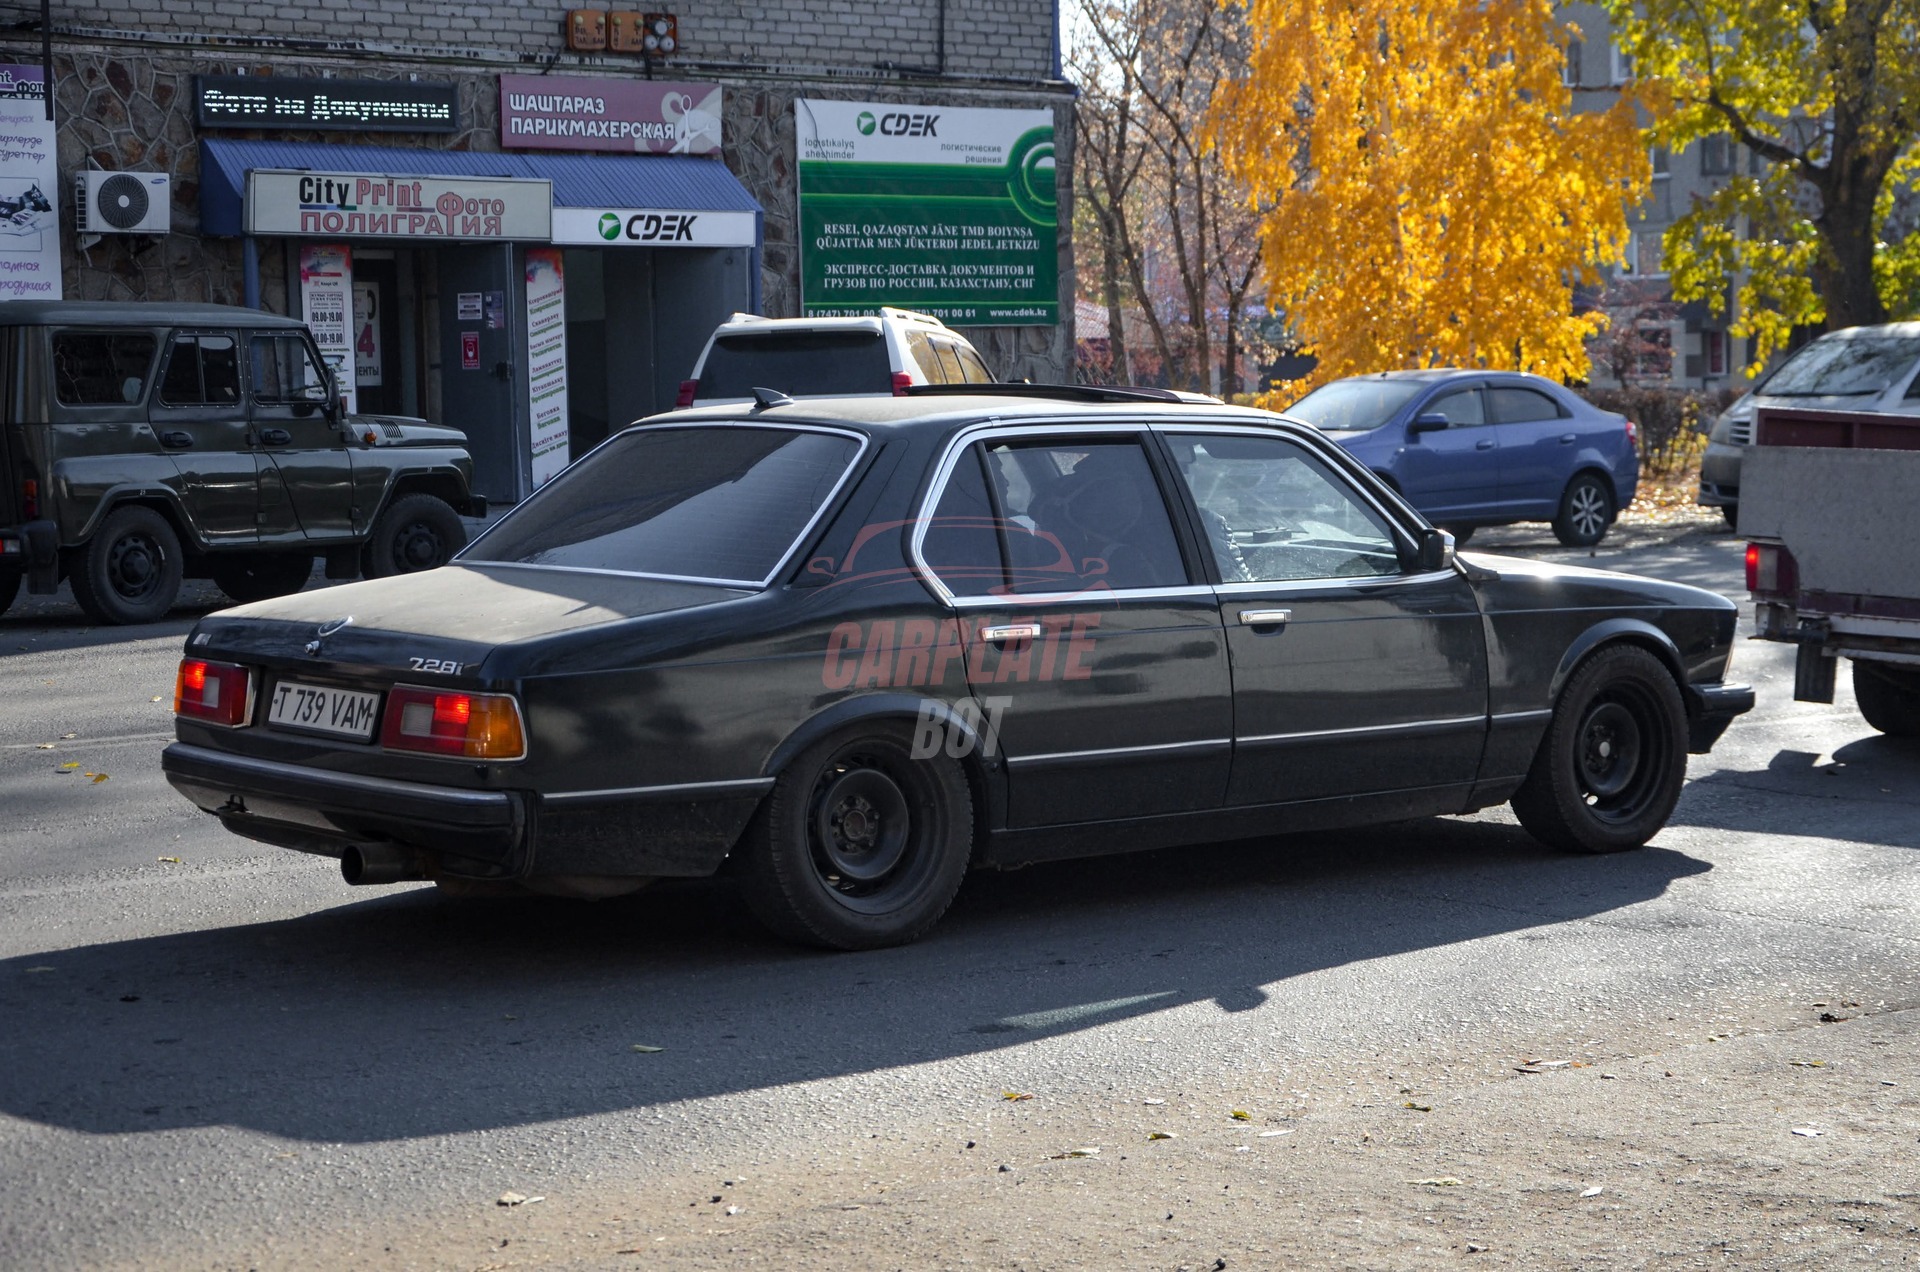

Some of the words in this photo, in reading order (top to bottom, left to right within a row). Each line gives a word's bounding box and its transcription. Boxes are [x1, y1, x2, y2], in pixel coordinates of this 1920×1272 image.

[204, 90, 267, 112] Фото
[275, 97, 305, 114] на
[312, 96, 449, 120] Документы
[509, 93, 605, 114] ШАШТАРАЗ
[510, 117, 676, 139] ПАРИКМАХЕРСКАЯ
[880, 113, 941, 137] CDEK
[940, 143, 1002, 153] логистические
[965, 155, 1002, 164] решения
[299, 177, 350, 207] City
[356, 179, 422, 207] Print
[626, 214, 698, 241] CDEK
[862, 224, 928, 236] QAZAQSTAN
[960, 226, 985, 236] TMD
[877, 238, 901, 248] MEN
[961, 239, 994, 249] JEDEL
[996, 239, 1040, 250] JETKIZU
[824, 264, 947, 276] ЭКСПРЕСС-ДОСТАВКА
[949, 265, 1024, 276] ДОКУМЕНТОВ
[1026, 265, 1035, 275] И
[824, 278, 866, 288] ГРУЗОВ
[870, 278, 886, 288] ПО
[889, 278, 938, 289] РОССИИ,
[940, 278, 1012, 290] КАЗАХСТАНУ,
[1014, 278, 1036, 288] СНГ
[933, 308, 949, 317] 701
[952, 308, 963, 317] 00
[965, 308, 976, 317] 61
[990, 307, 1047, 317] www.cdek.kz
[409, 658, 464, 676] 728i
[278, 686, 292, 718] T
[293, 688, 326, 722] 739
[329, 693, 371, 731] VAM
